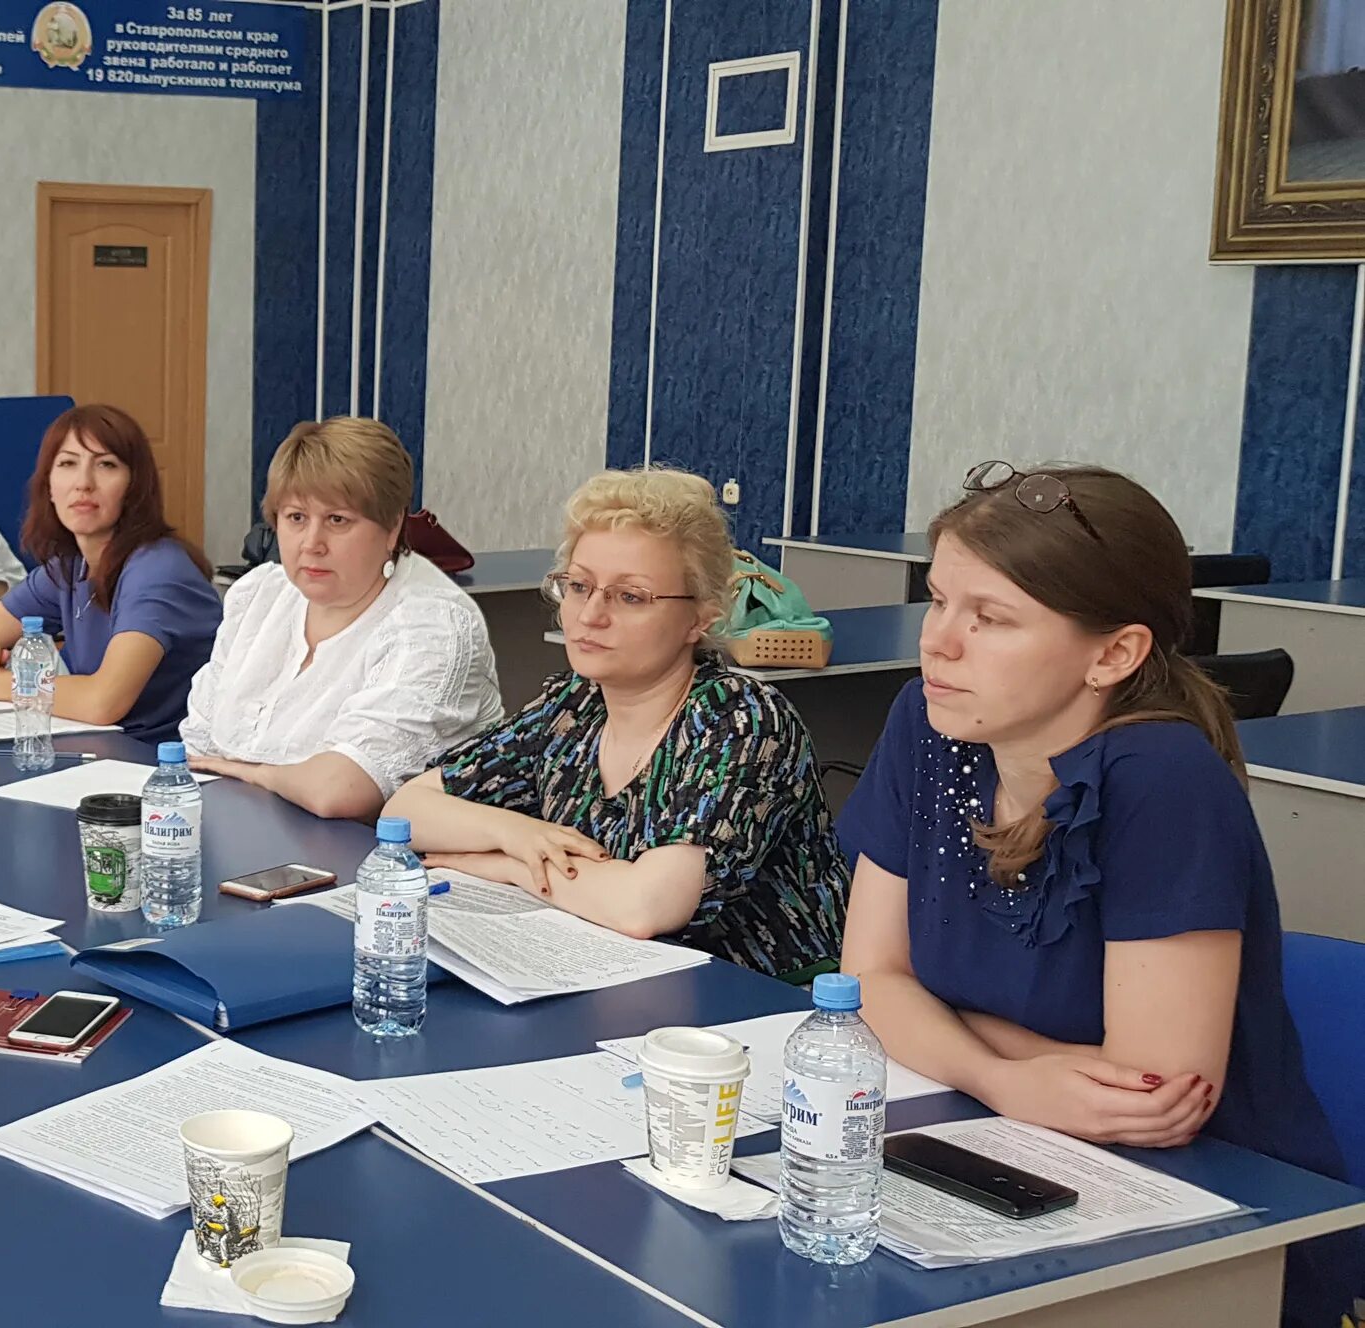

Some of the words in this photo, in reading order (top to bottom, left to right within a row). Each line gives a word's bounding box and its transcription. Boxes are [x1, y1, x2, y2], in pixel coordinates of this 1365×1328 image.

[167, 6, 185, 20] За
[187, 7, 203, 21] 85
[208, 12, 233, 22] лет
[115, 23, 124, 33] в
[126, 22, 243, 40] Ставропольском
[246, 31, 279, 43] крае
[107, 39, 224, 54] руководителями
[225, 46, 289, 58] среднего
[102, 56, 146, 67] звена
[150, 56, 216, 71] работало
[219, 62, 228, 71] и
[232, 61, 293, 75] работает
[86, 68, 104, 82] 19
[229, 79, 302, 93] техникума
[144, 821, 193, 840] Пилигрим
[376, 907, 412, 919] Пилигрим
[714, 1081, 739, 1143] LIFE
[717, 1144, 730, 1174] CITY
